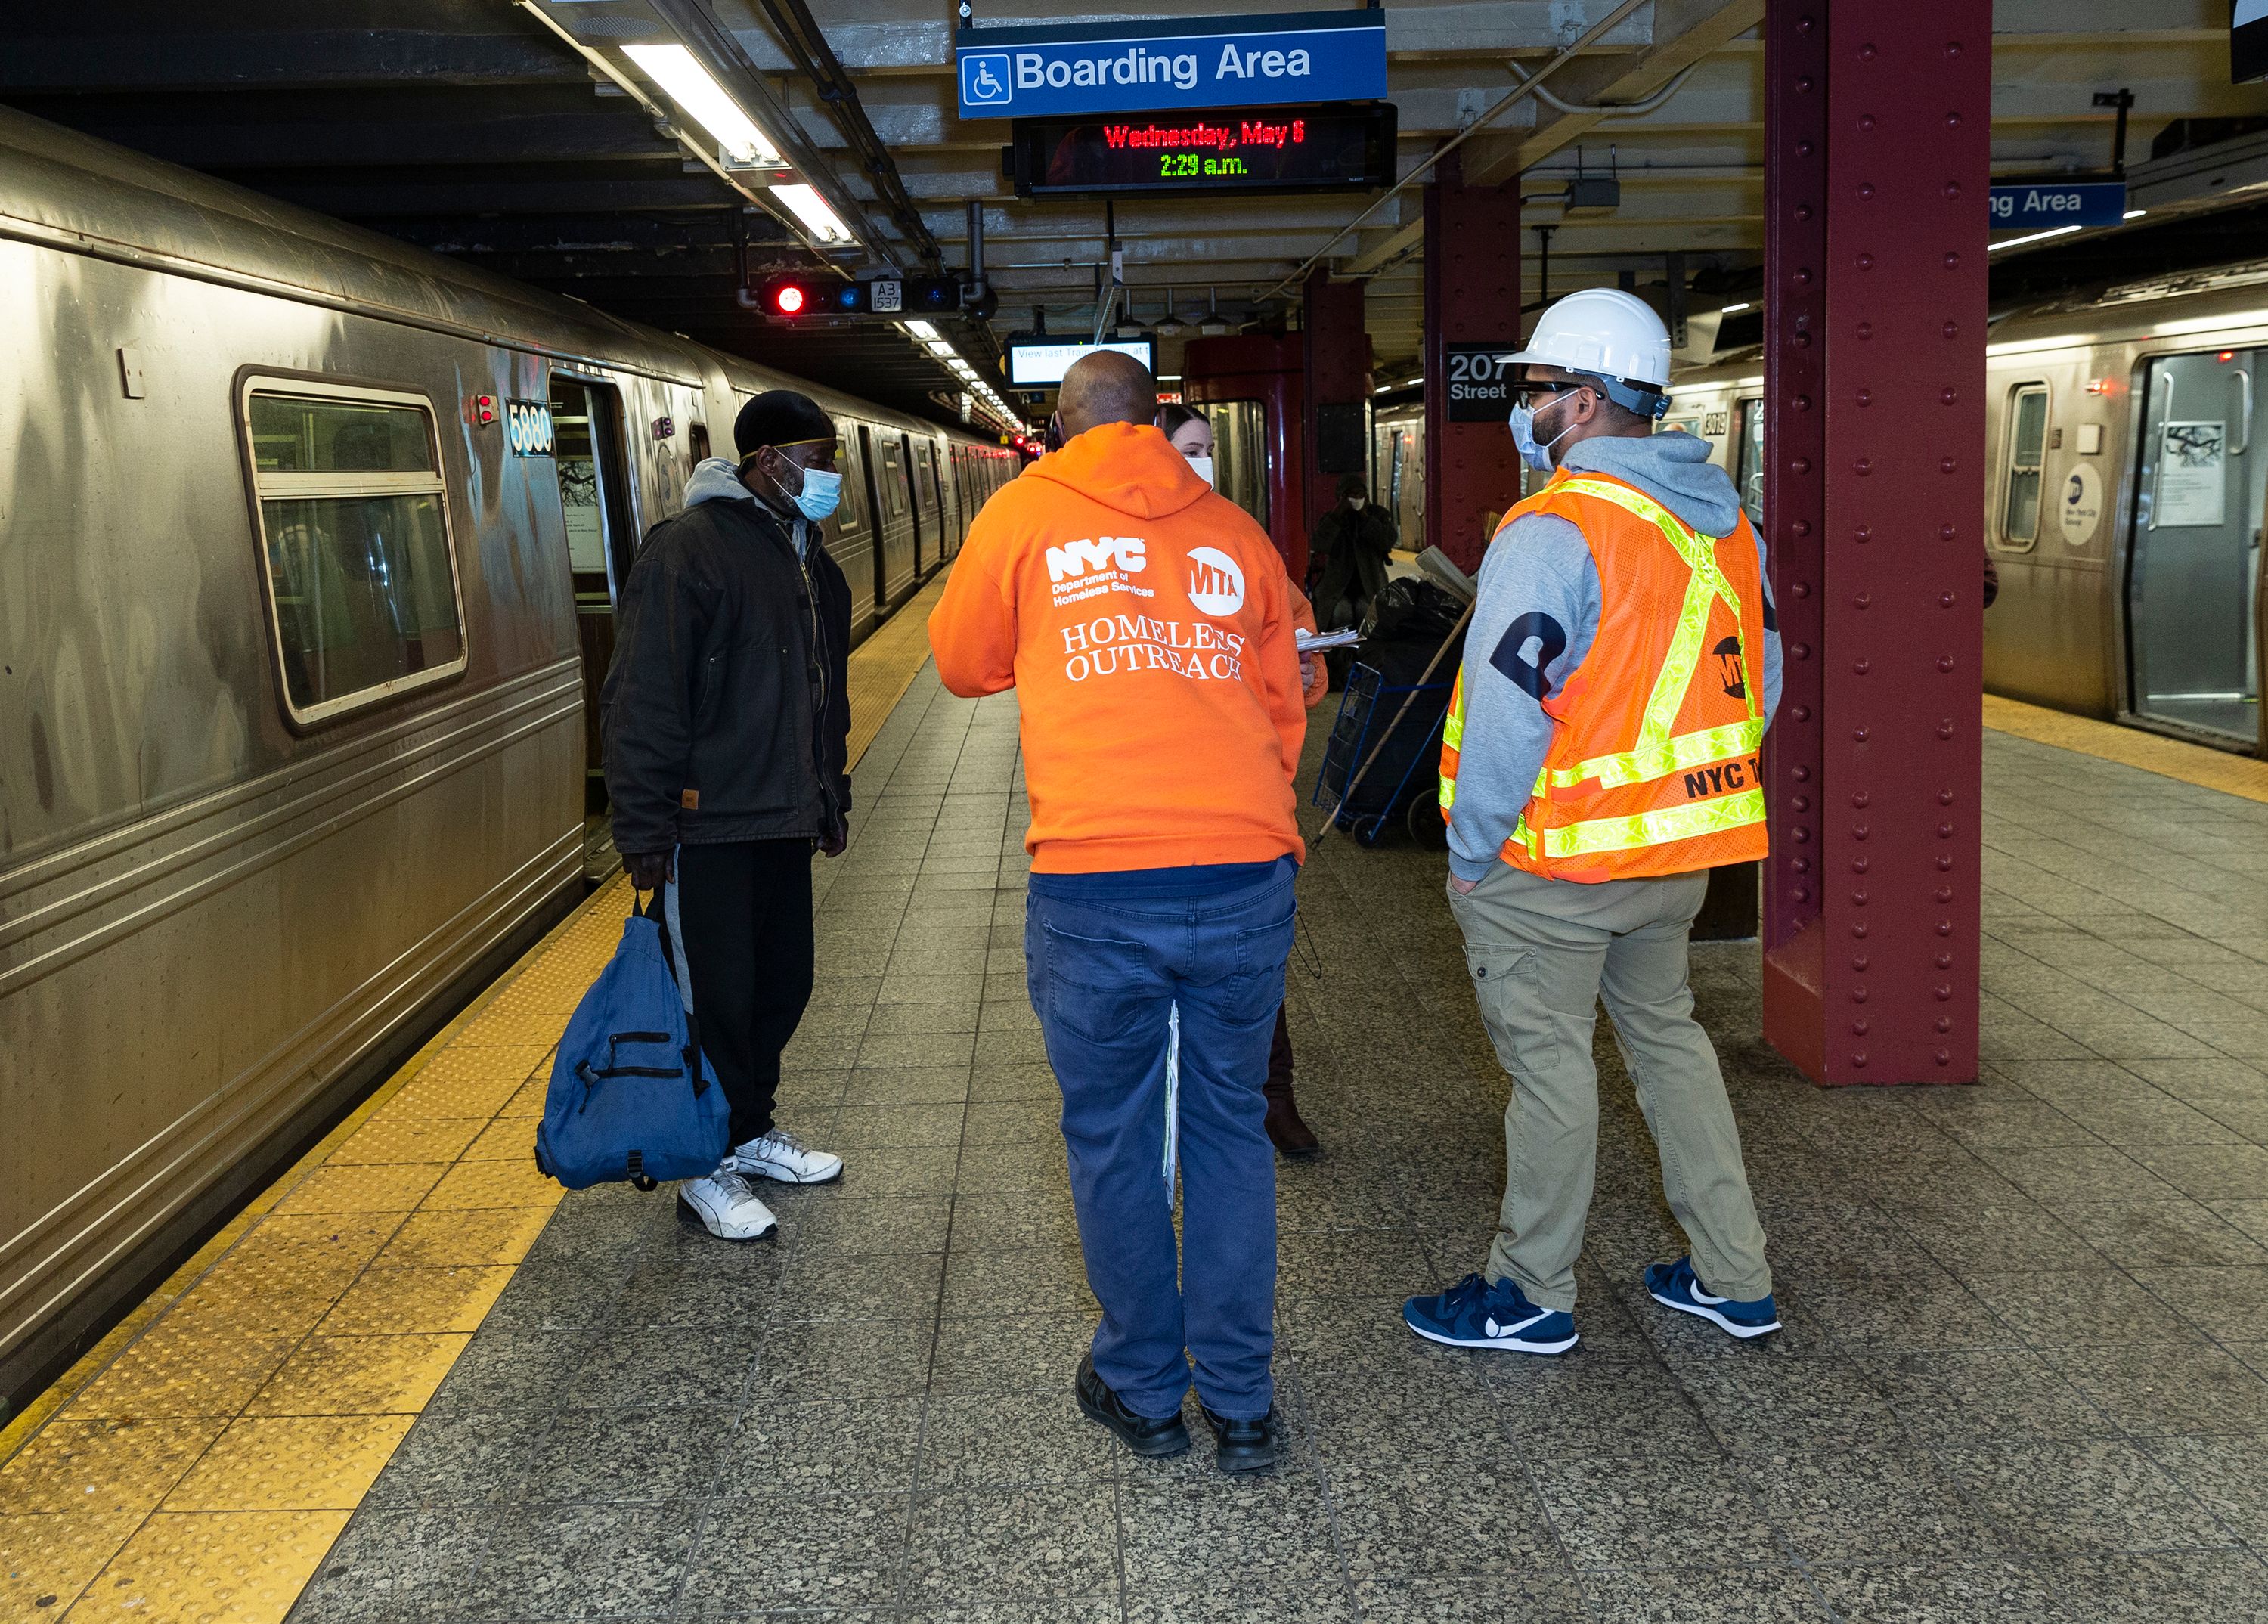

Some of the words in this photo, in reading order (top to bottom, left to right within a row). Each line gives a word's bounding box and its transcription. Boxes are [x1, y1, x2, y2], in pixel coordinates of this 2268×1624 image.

[1016, 48, 1198, 90] Boarding
[1216, 44, 1310, 79] Area
[1104, 122, 1237, 150] Wednesday,
[1241, 121, 1288, 149] May
[1293, 120, 1305, 144] 6
[1160, 153, 1198, 177] 2:29
[1204, 157, 1247, 175] a.m.
[2022, 190, 2082, 212] Area
[874, 297, 899, 308] 1537
[878, 283, 896, 296] A3
[1018, 349, 1042, 358] View
[1045, 348, 1063, 358] last
[1066, 347, 1089, 357] Train
[1133, 346, 1142, 355] at
[1450, 354, 1510, 381] 207
[1450, 383, 1507, 400] Street
[509, 404, 552, 451] 5880
[1046, 537, 1146, 582] NYC
[1052, 570, 1117, 595] Department
[1120, 573, 1128, 581] of
[1185, 554, 1239, 598] MTA
[1053, 584, 1109, 607] Homeless
[1111, 581, 1154, 597] Services
[1060, 614, 1246, 656] HOMELESS
[1065, 643, 1244, 683] OUTREACH
[1684, 763, 1745, 798] NYC
